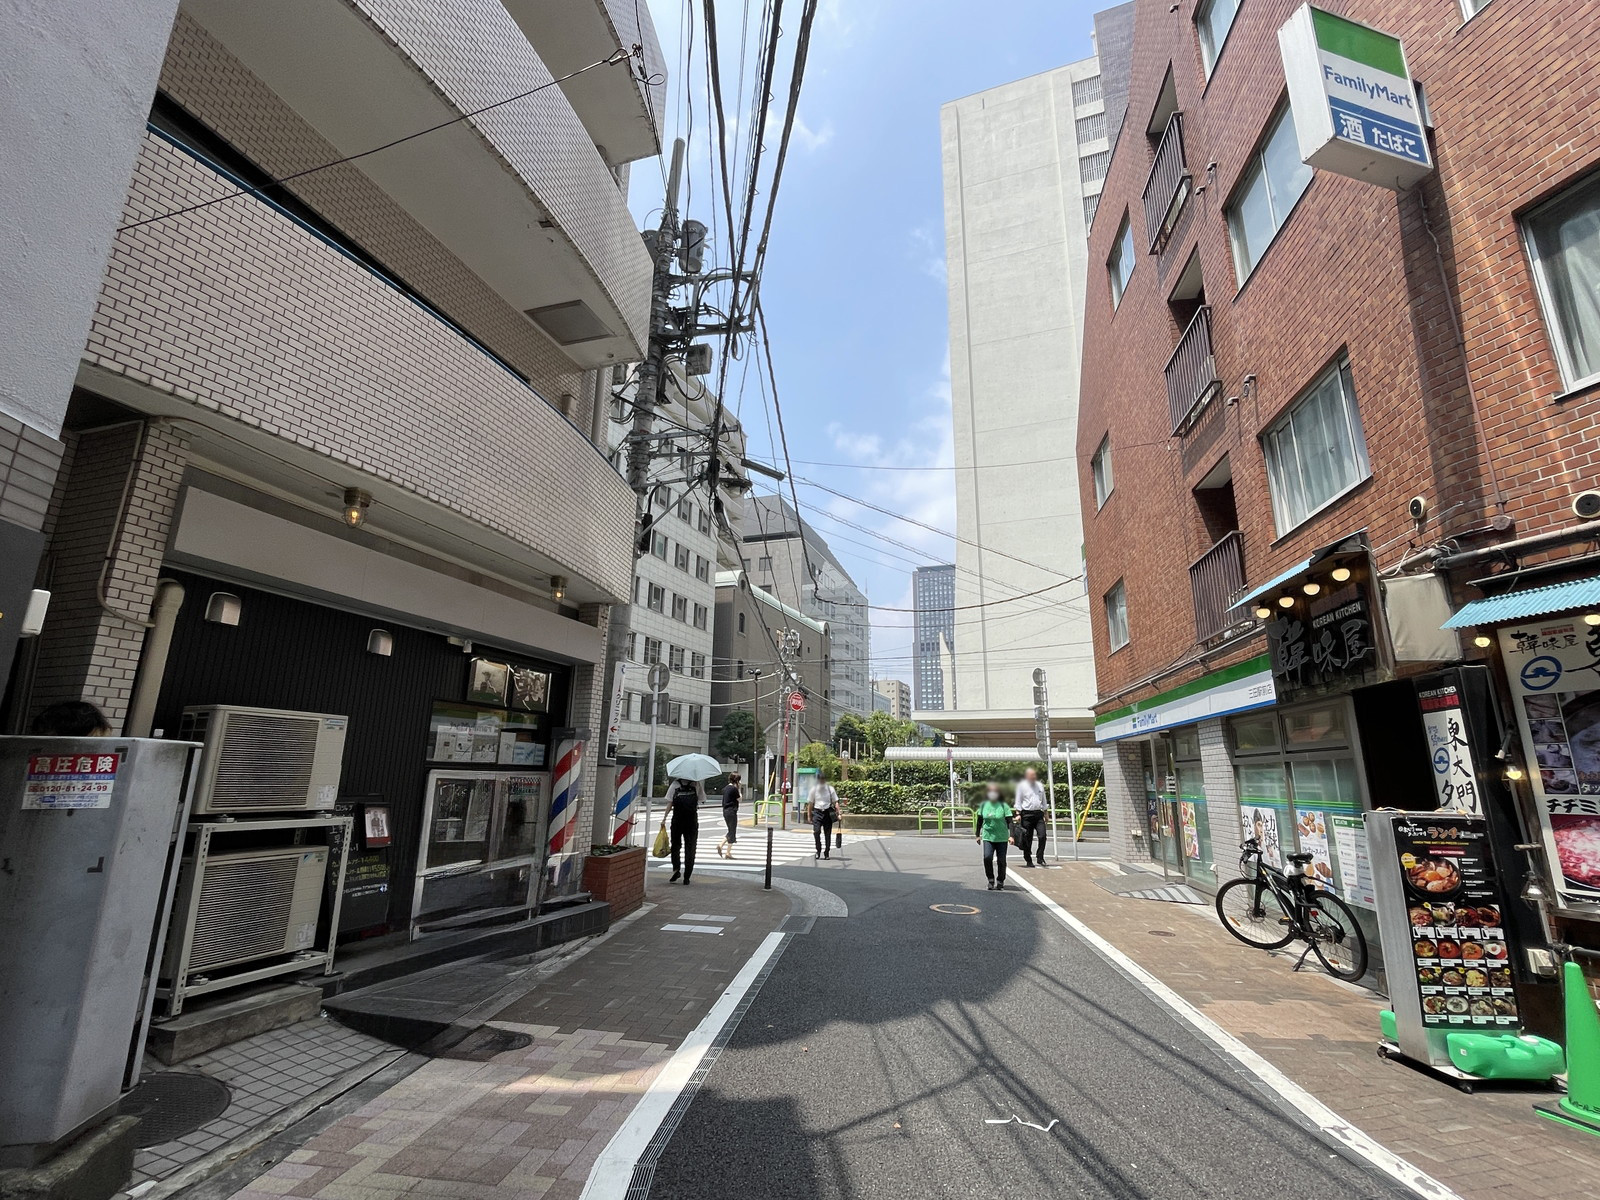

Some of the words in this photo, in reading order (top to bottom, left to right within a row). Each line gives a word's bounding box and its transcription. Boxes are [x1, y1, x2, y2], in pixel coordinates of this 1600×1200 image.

[1323, 63, 1413, 110] FamilyMart
[1339, 112, 1365, 145] 酒
[1371, 126, 1420, 158] たばこ
[1312, 612, 1335, 629] KOREAN
[1335, 601, 1361, 619] KITCHEN
[1508, 629, 1579, 656] 韓味屋
[1136, 712, 1158, 729] FamilyMart
[34, 755, 114, 773] 高圧危険
[1442, 717, 1477, 814] 東大門
[40, 785, 108, 793] 0120-81-24-99
[1441, 779, 1458, 811] タ
[1427, 826, 1458, 840] ランチ
